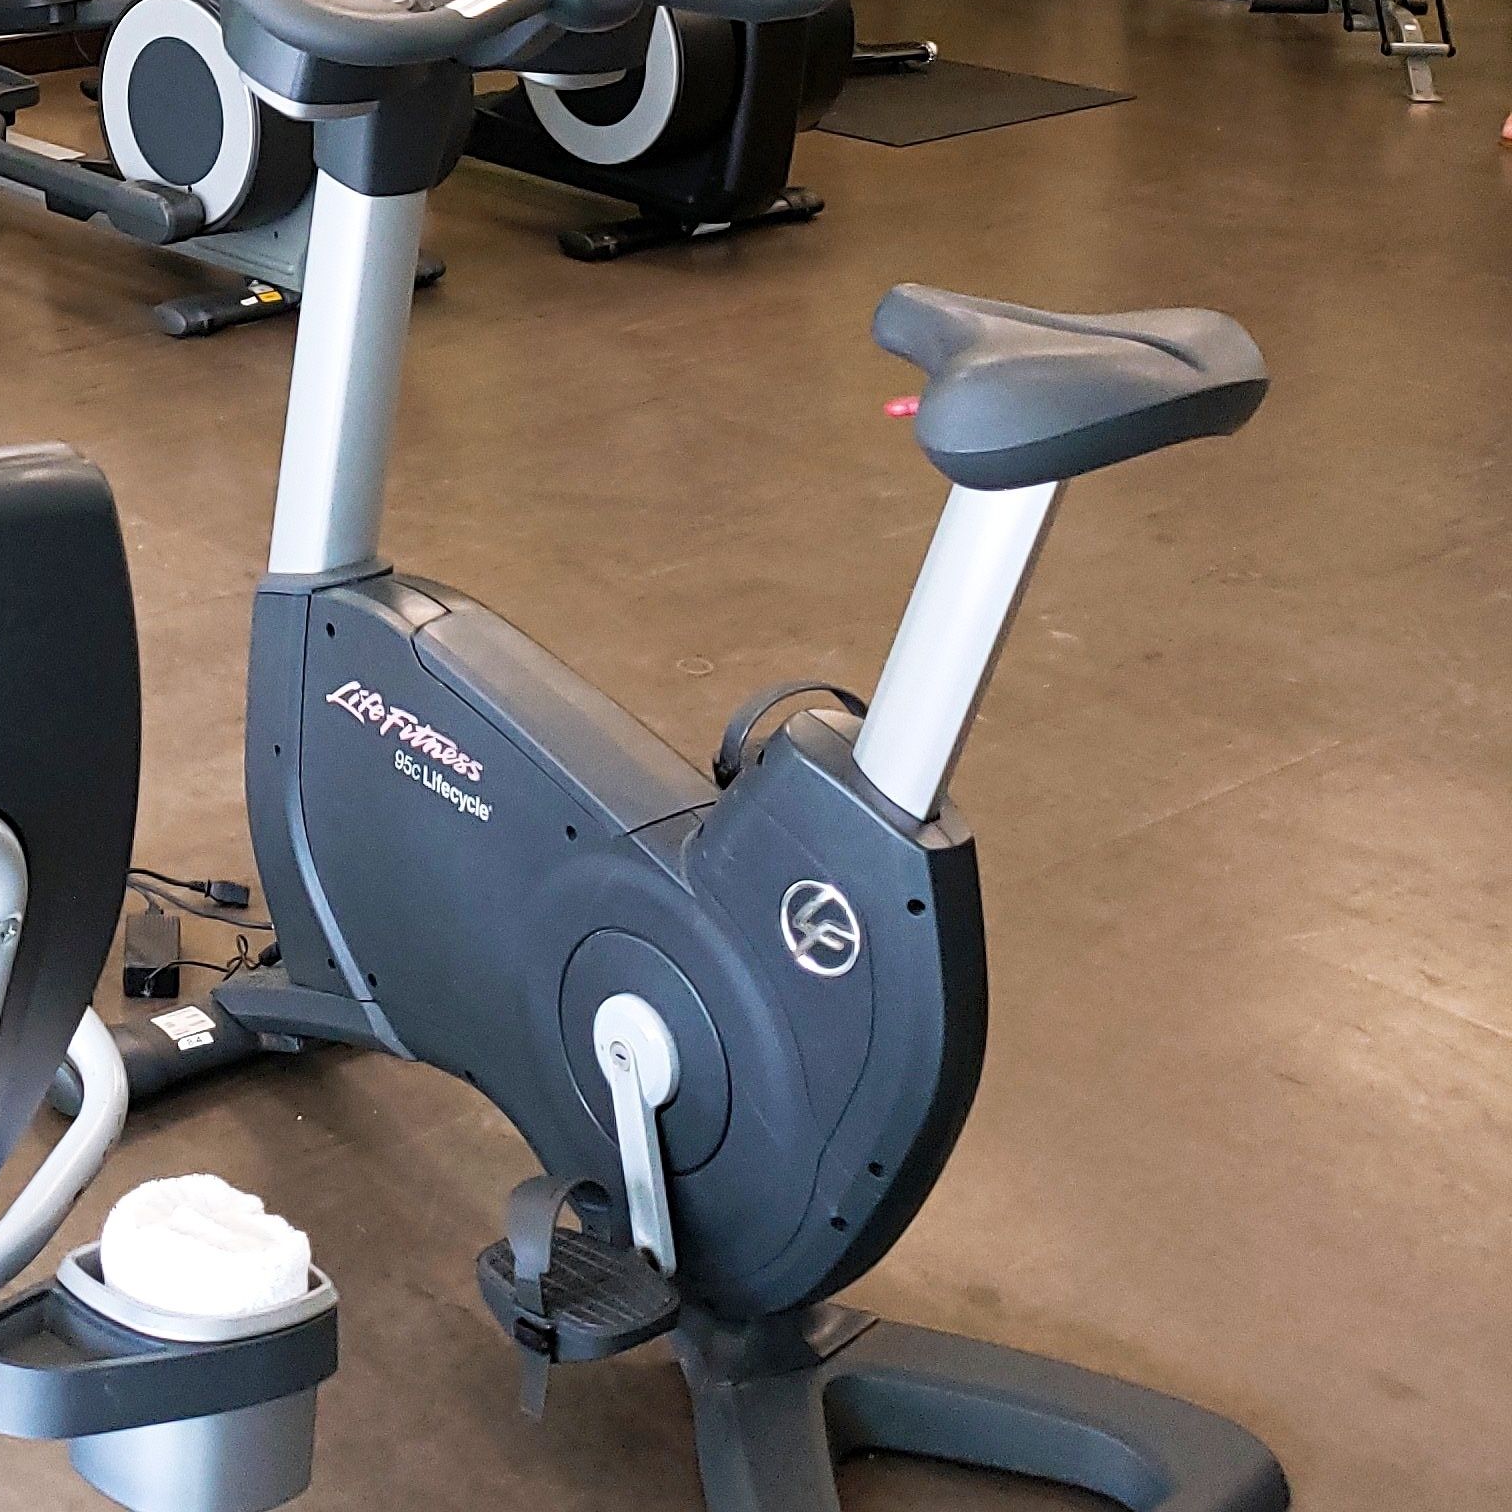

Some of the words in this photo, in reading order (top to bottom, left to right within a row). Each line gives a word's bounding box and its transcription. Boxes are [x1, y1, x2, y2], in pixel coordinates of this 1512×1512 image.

[325, 680, 386, 724] Life
[379, 705, 484, 782] Fitness
[394, 749, 421, 781] 95c
